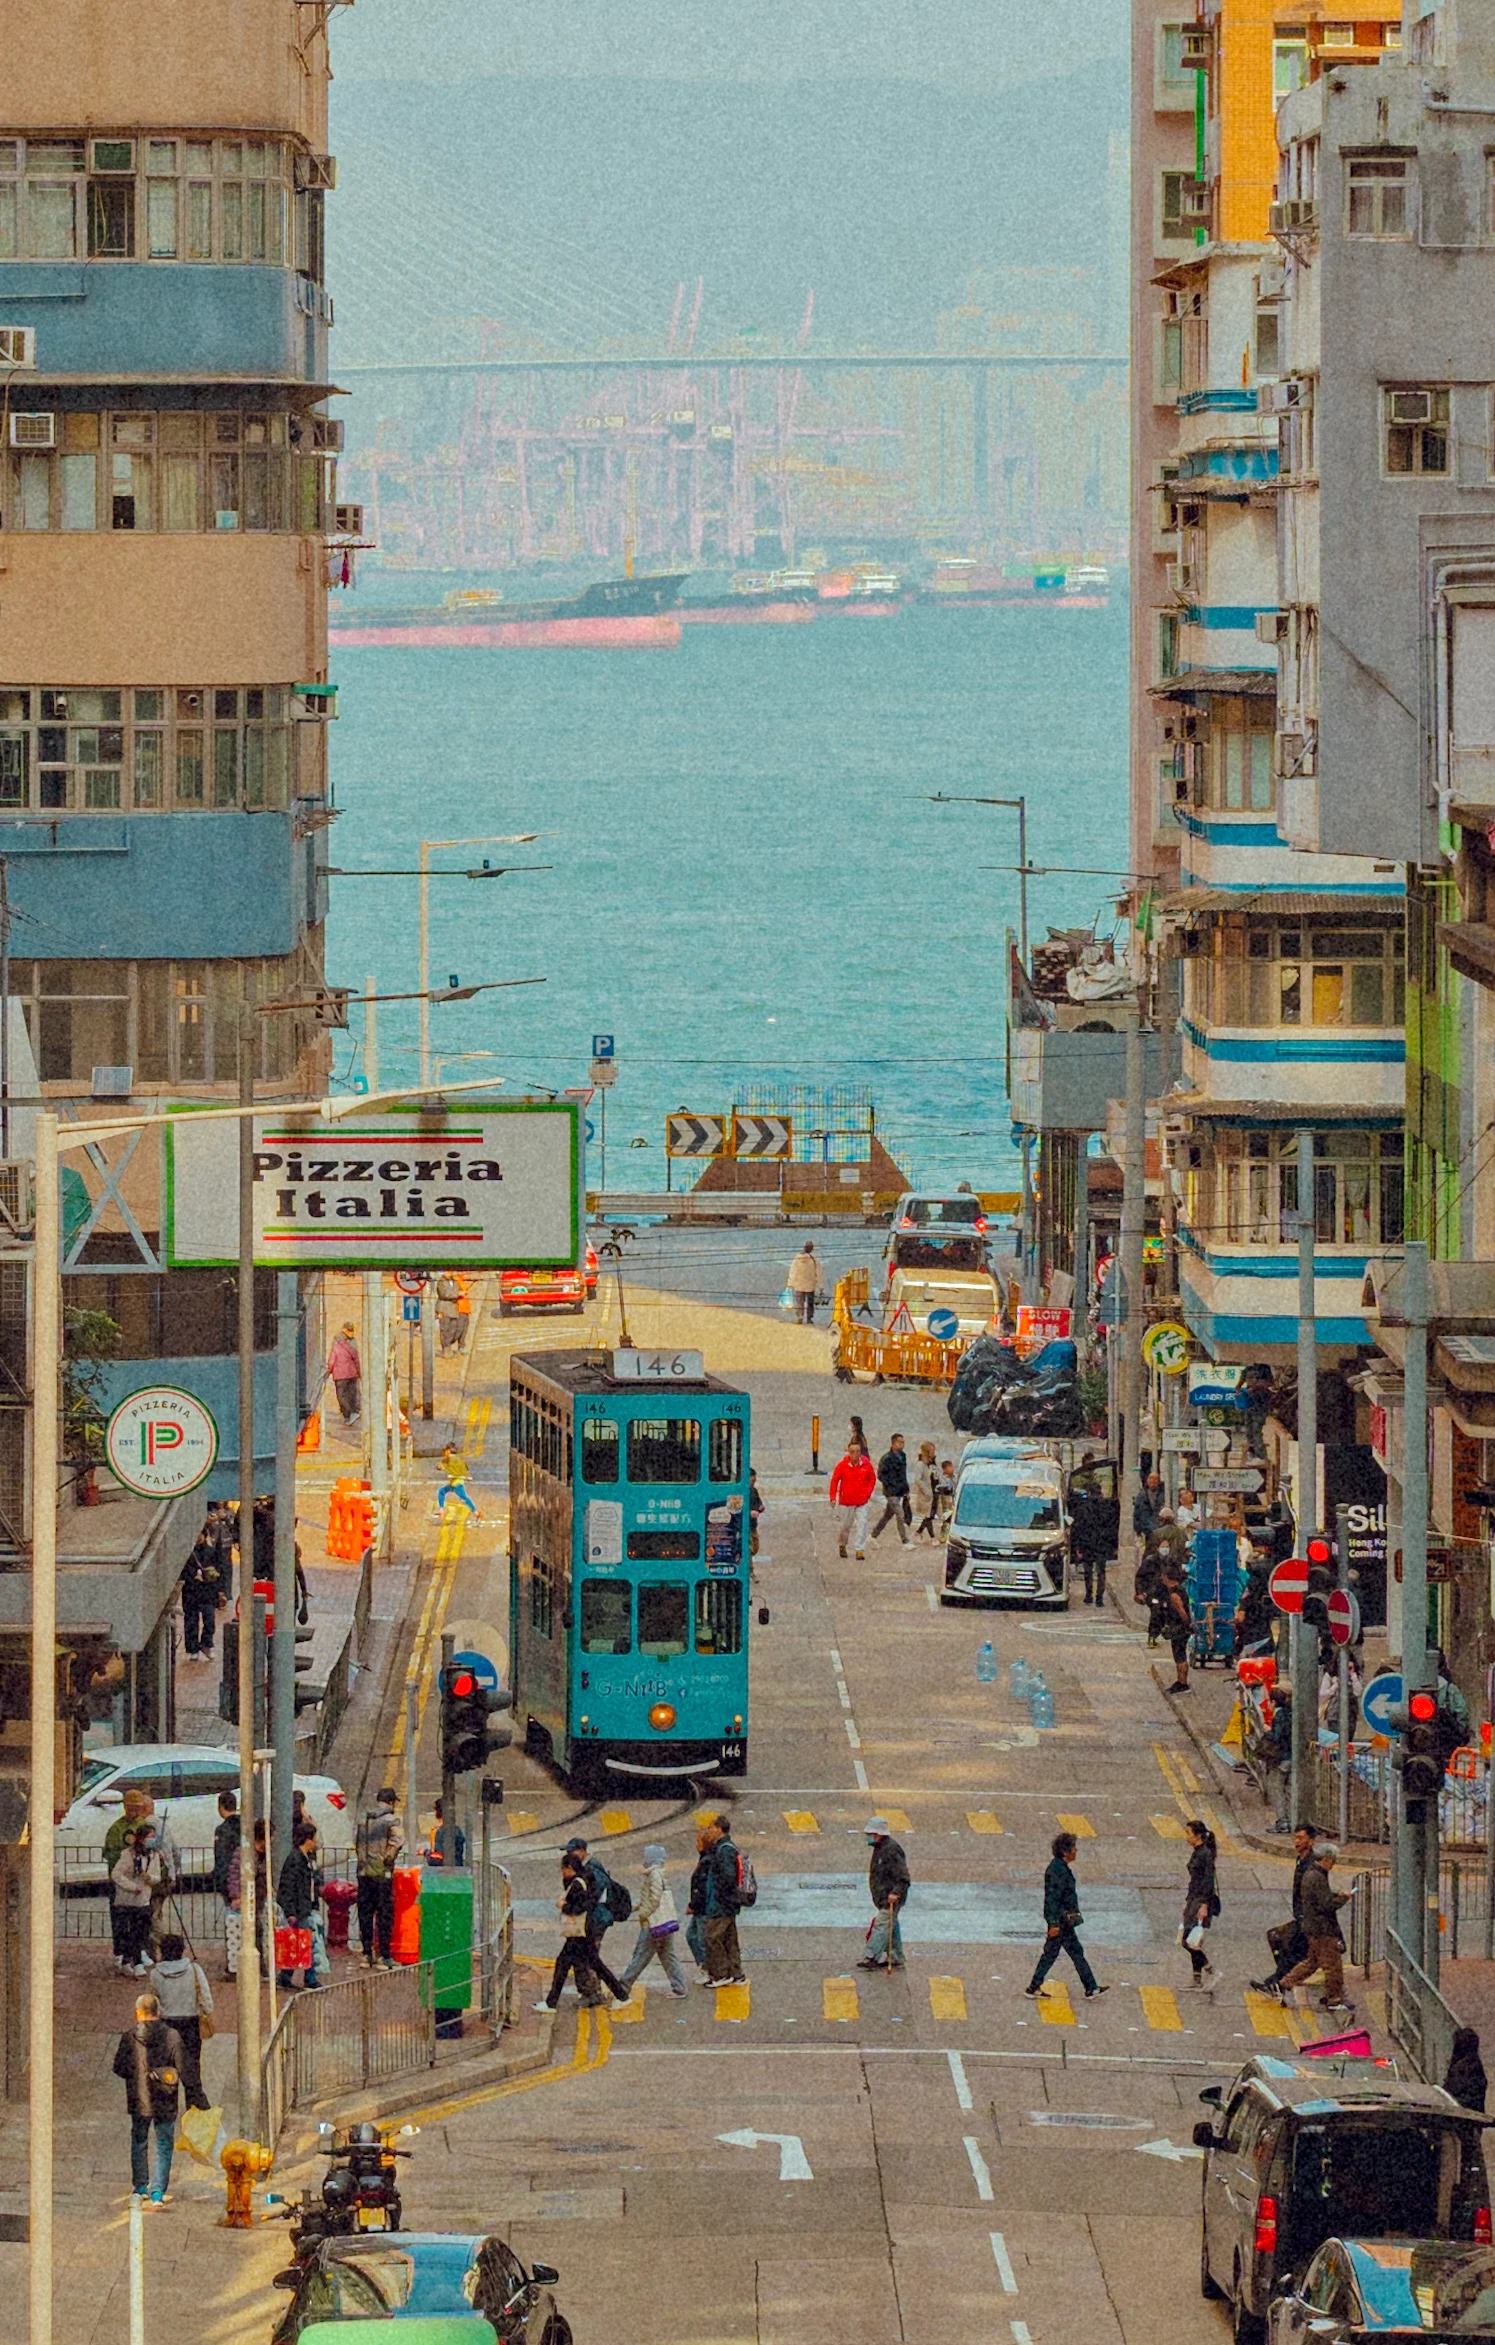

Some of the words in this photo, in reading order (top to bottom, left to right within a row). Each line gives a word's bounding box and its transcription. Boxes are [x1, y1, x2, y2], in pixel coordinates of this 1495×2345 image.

[595, 1036, 611, 1055] P
[252, 1151, 503, 1182] Pizzeria
[276, 1188, 470, 1217] Italia
[1027, 1309, 1061, 1320] SLOW
[635, 1355, 686, 1375] 146
[131, 1400, 191, 1418] PIZZERIA
[585, 1403, 606, 1414] 146
[722, 1402, 741, 1413] 146
[139, 1472, 185, 1485] ITALIA
[1348, 1538, 1373, 1549] Hong
[1348, 1548, 1384, 1559] Coming
[721, 1743, 741, 1758] 146
